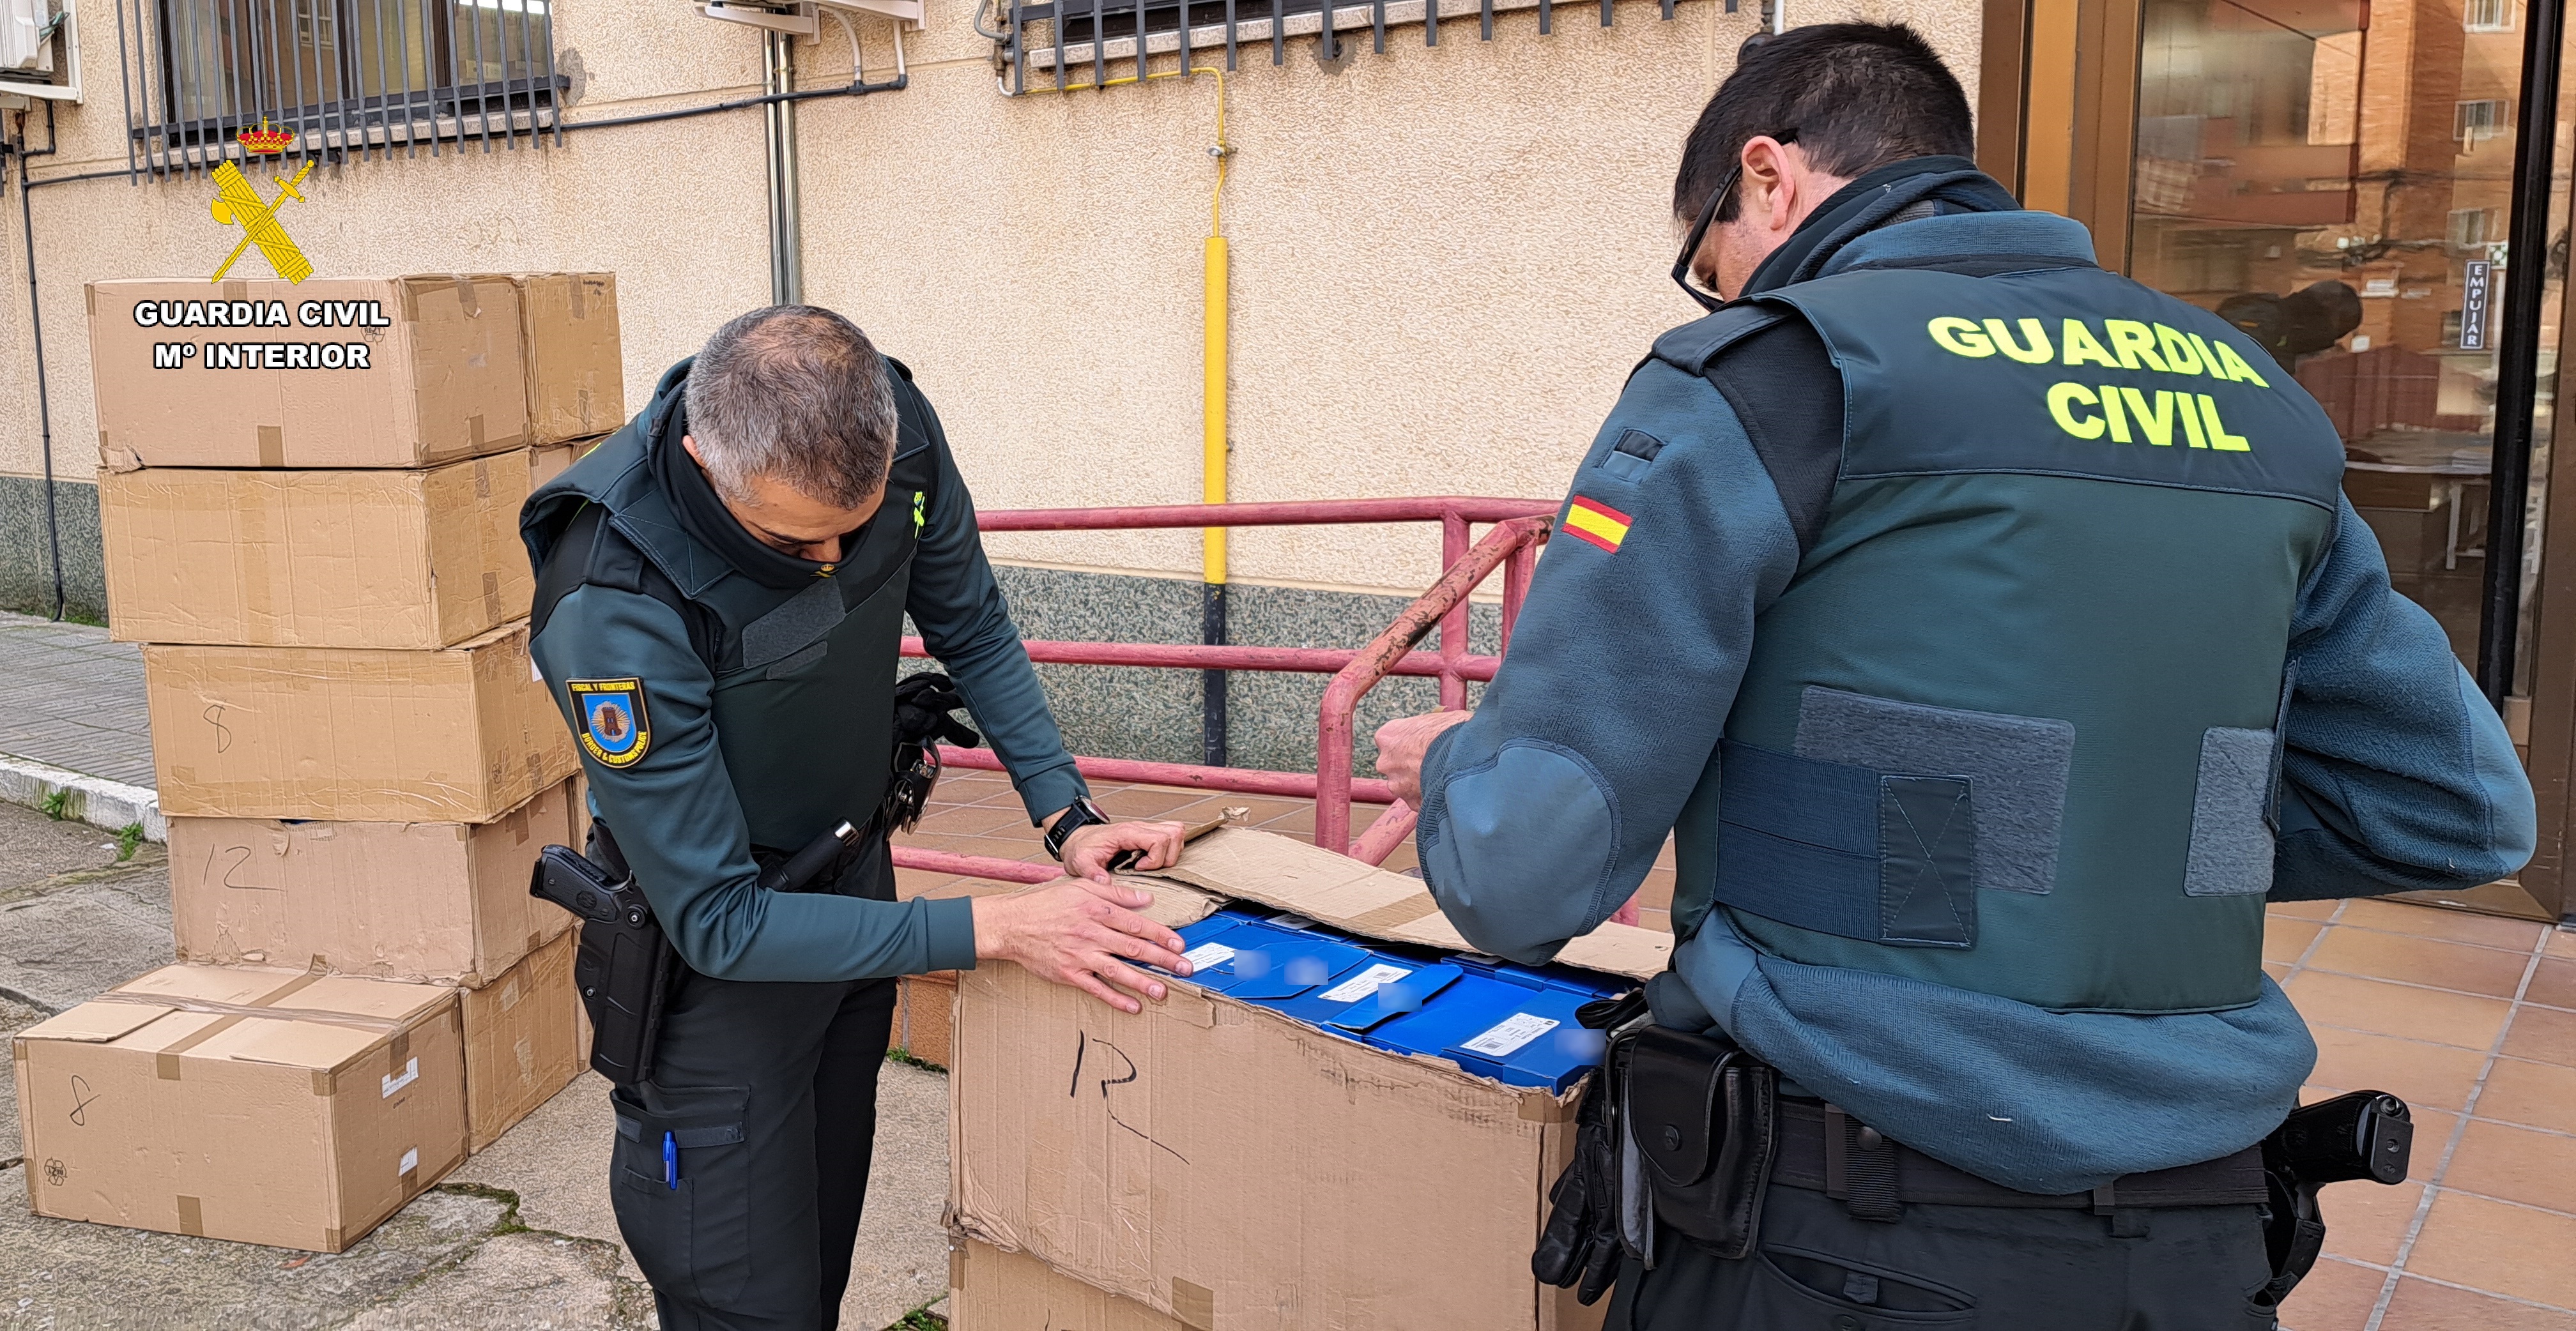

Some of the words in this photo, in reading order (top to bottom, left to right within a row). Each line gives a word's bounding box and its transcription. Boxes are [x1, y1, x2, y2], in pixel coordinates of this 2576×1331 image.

[2467, 265, 2484, 345] EMPUJAR
[1927, 316, 2269, 388] GUARDIA
[2046, 382, 2250, 452] CIVIL
[599, 681, 635, 691] FRONTERAS
[203, 699, 232, 754] 8
[581, 732, 602, 757] BORDER
[602, 752, 608, 761] &
[608, 749, 638, 764] CUSTOMS
[634, 731, 647, 753] POLICE
[203, 842, 289, 893] 12
[69, 1074, 102, 1127] 8
